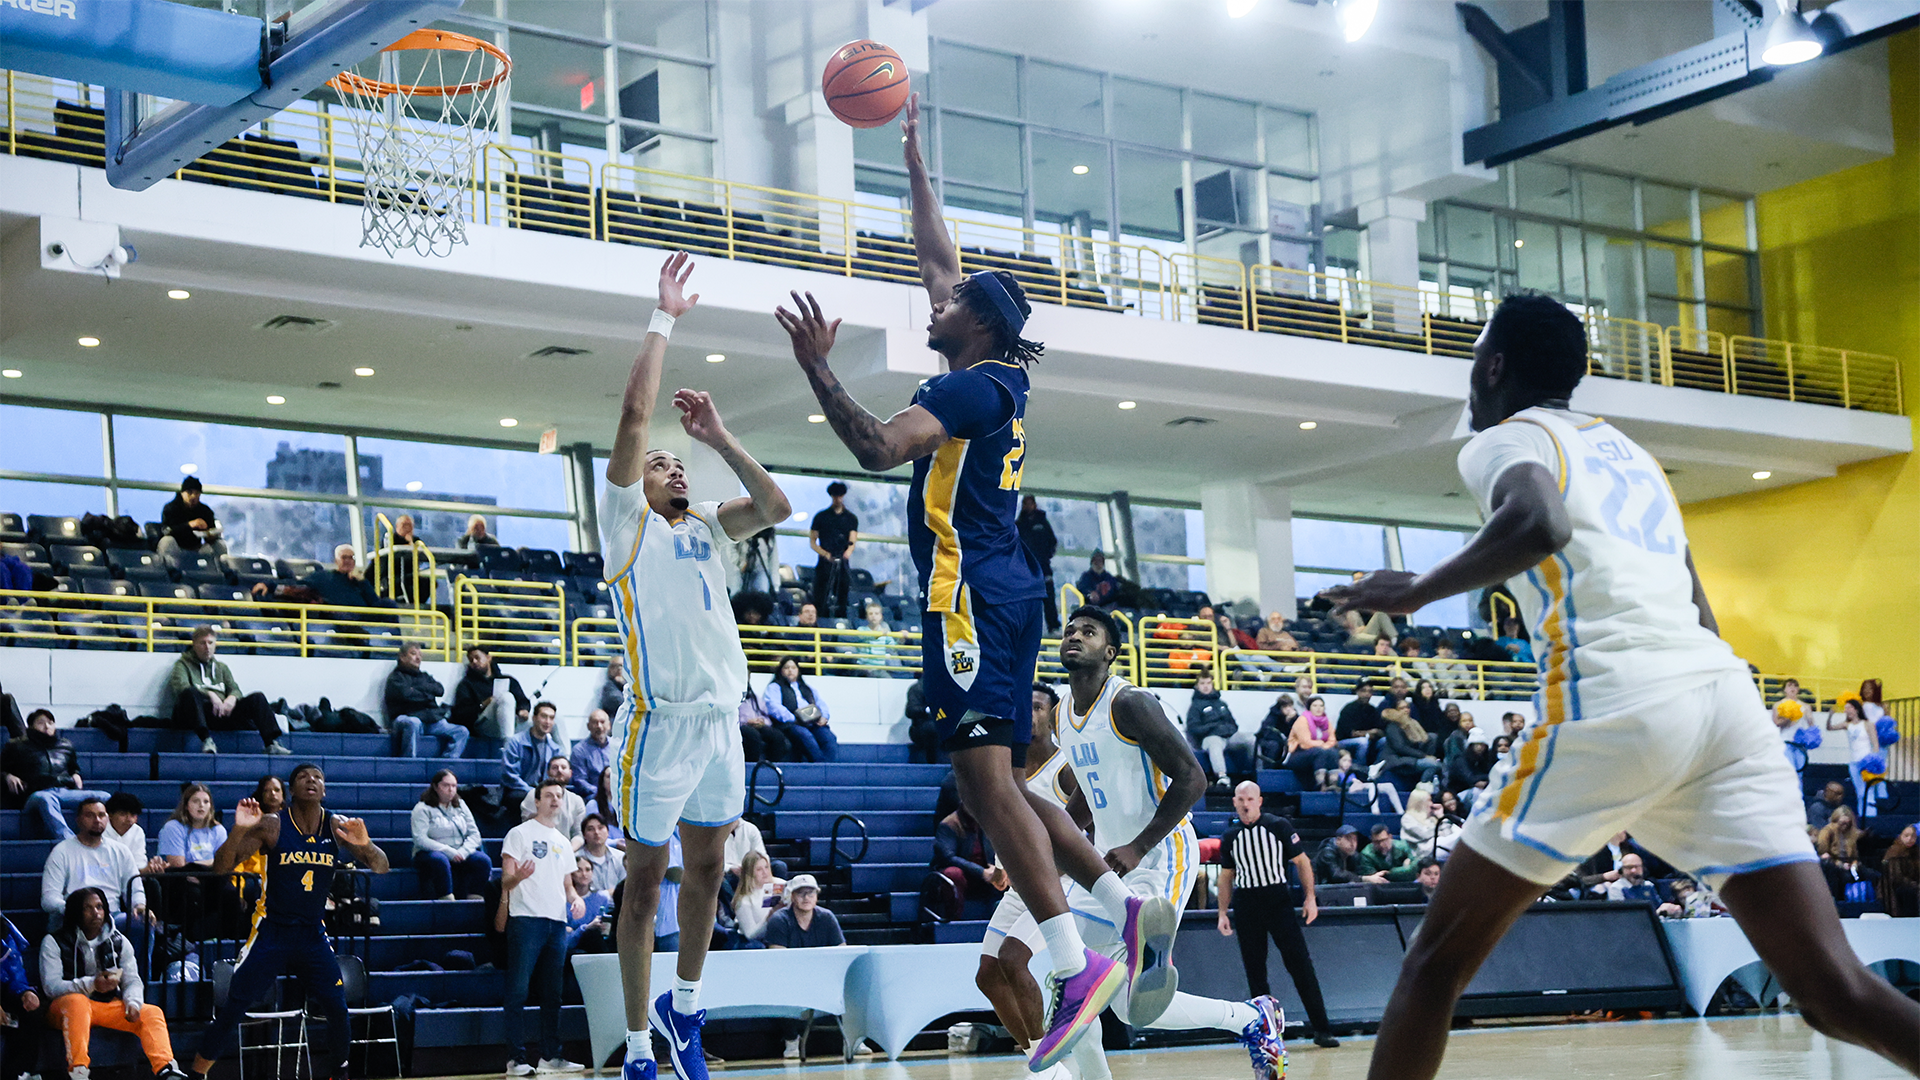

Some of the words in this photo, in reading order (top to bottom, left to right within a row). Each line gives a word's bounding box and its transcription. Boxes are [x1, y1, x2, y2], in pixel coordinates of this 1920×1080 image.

[1596, 438, 1634, 461] SU
[1584, 456, 1676, 555] 22
[1070, 742, 1100, 768] LIU
[1087, 772, 1108, 809] 6
[301, 870, 314, 891] 4
